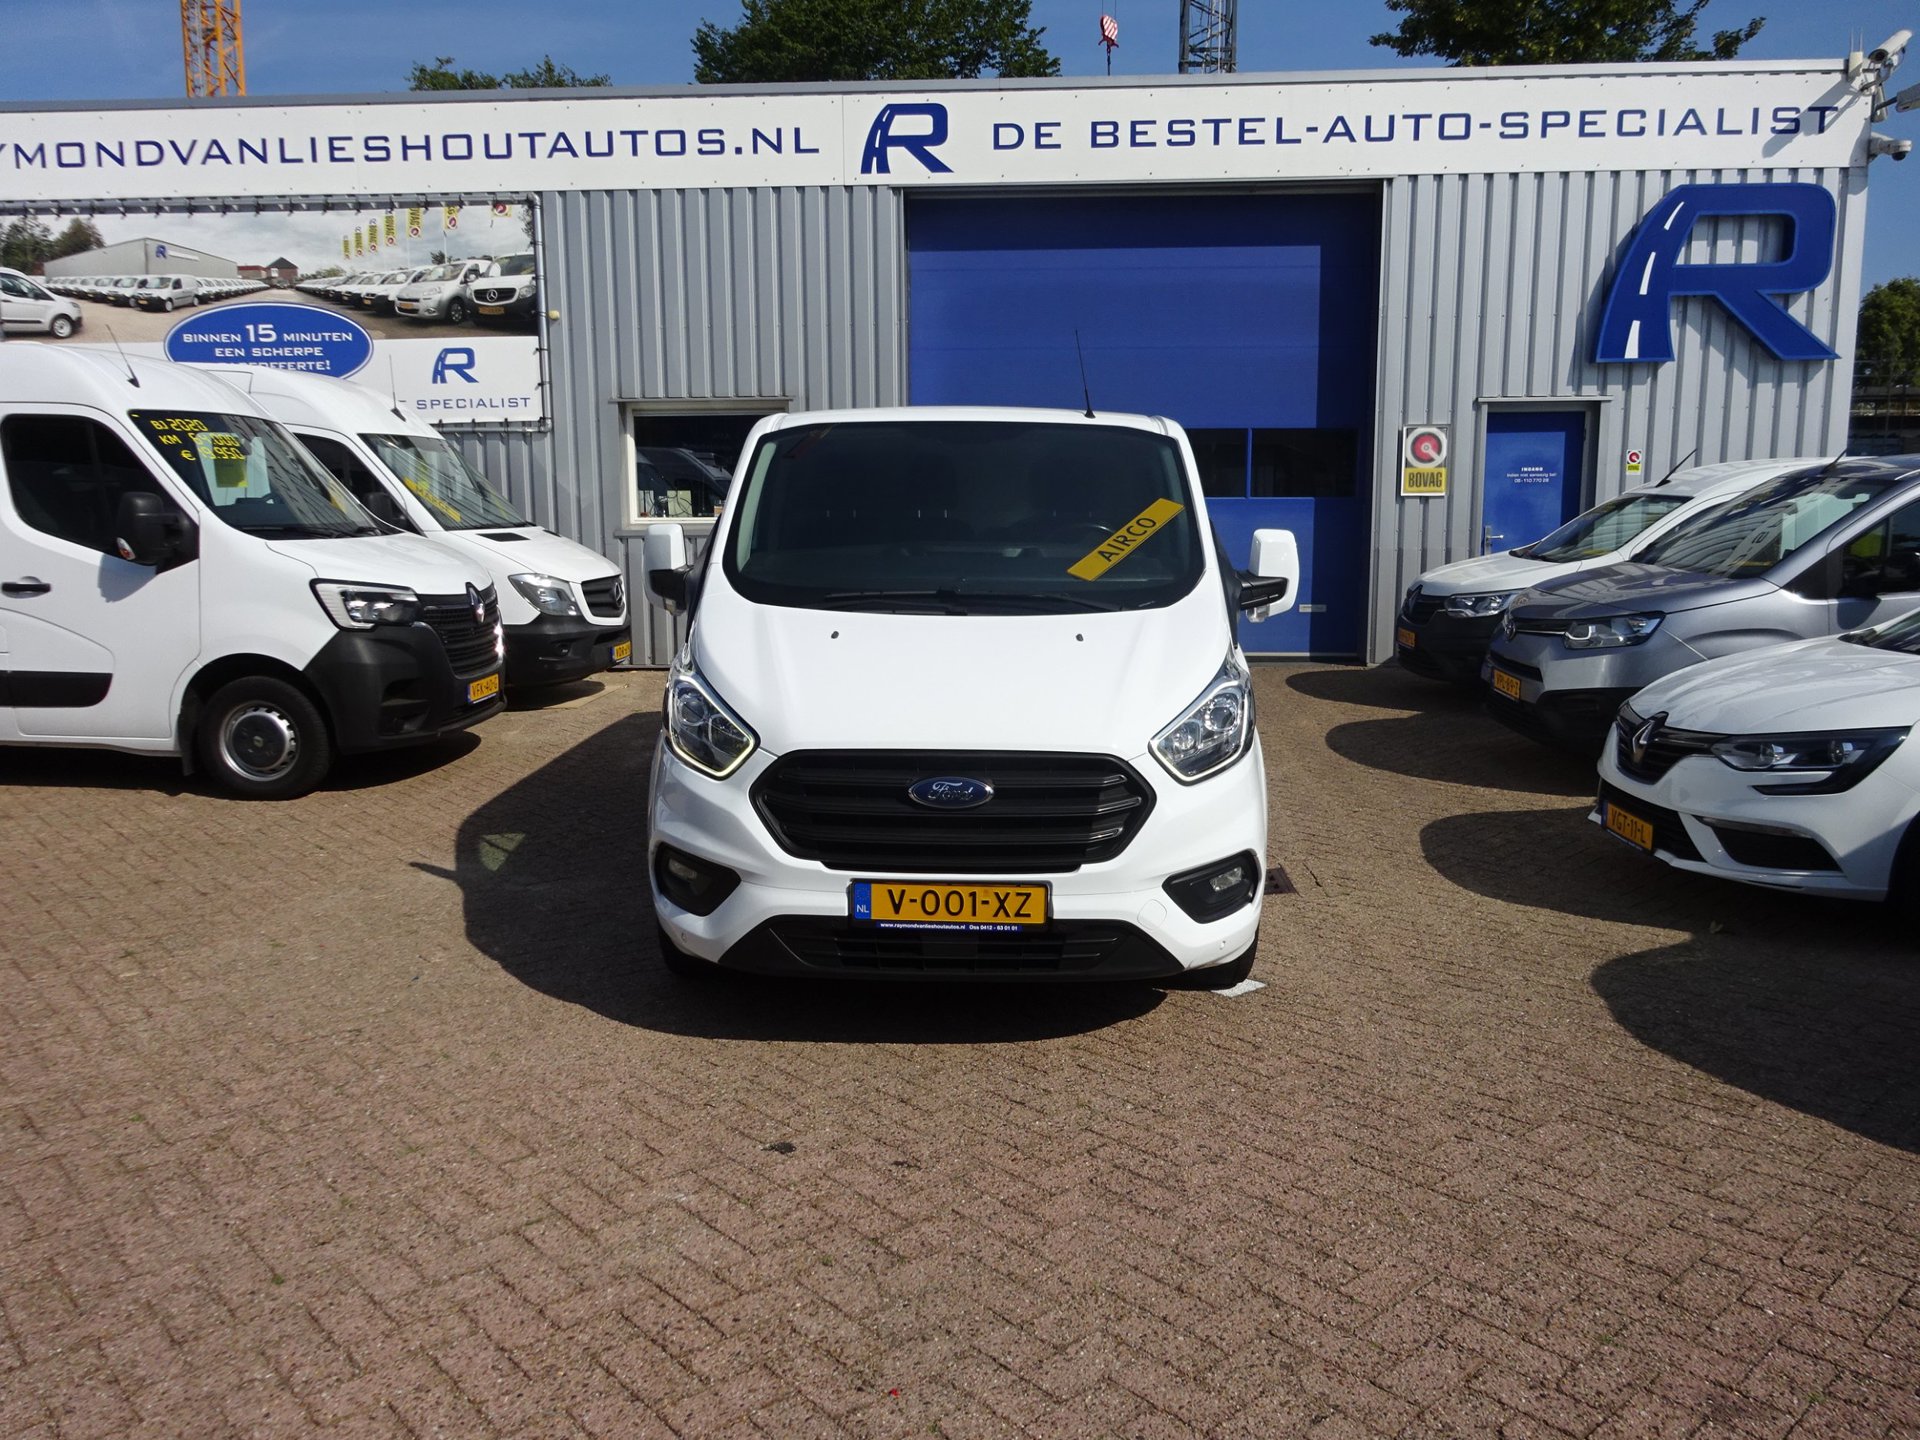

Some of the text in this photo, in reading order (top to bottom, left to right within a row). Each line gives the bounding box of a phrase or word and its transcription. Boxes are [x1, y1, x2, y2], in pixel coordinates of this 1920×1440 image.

[992, 106, 1839, 151] DE BESTEL-AUTO-SPECIALIST
[182, 324, 353, 343] BINNEN 15 MINUTEN
[214, 346, 324, 357] EEN SCHERPE
[416, 397, 531, 410] SPECIALIST
[166, 418, 208, 432] 2020
[158, 434, 182, 445] KM
[180, 449, 196, 461] €
[1408, 471, 1443, 488] BOVAG
[1097, 517, 1157, 562] AIRCO
[928, 781, 974, 801] Ford
[856, 888, 1032, 918] NL V-001-XZ
